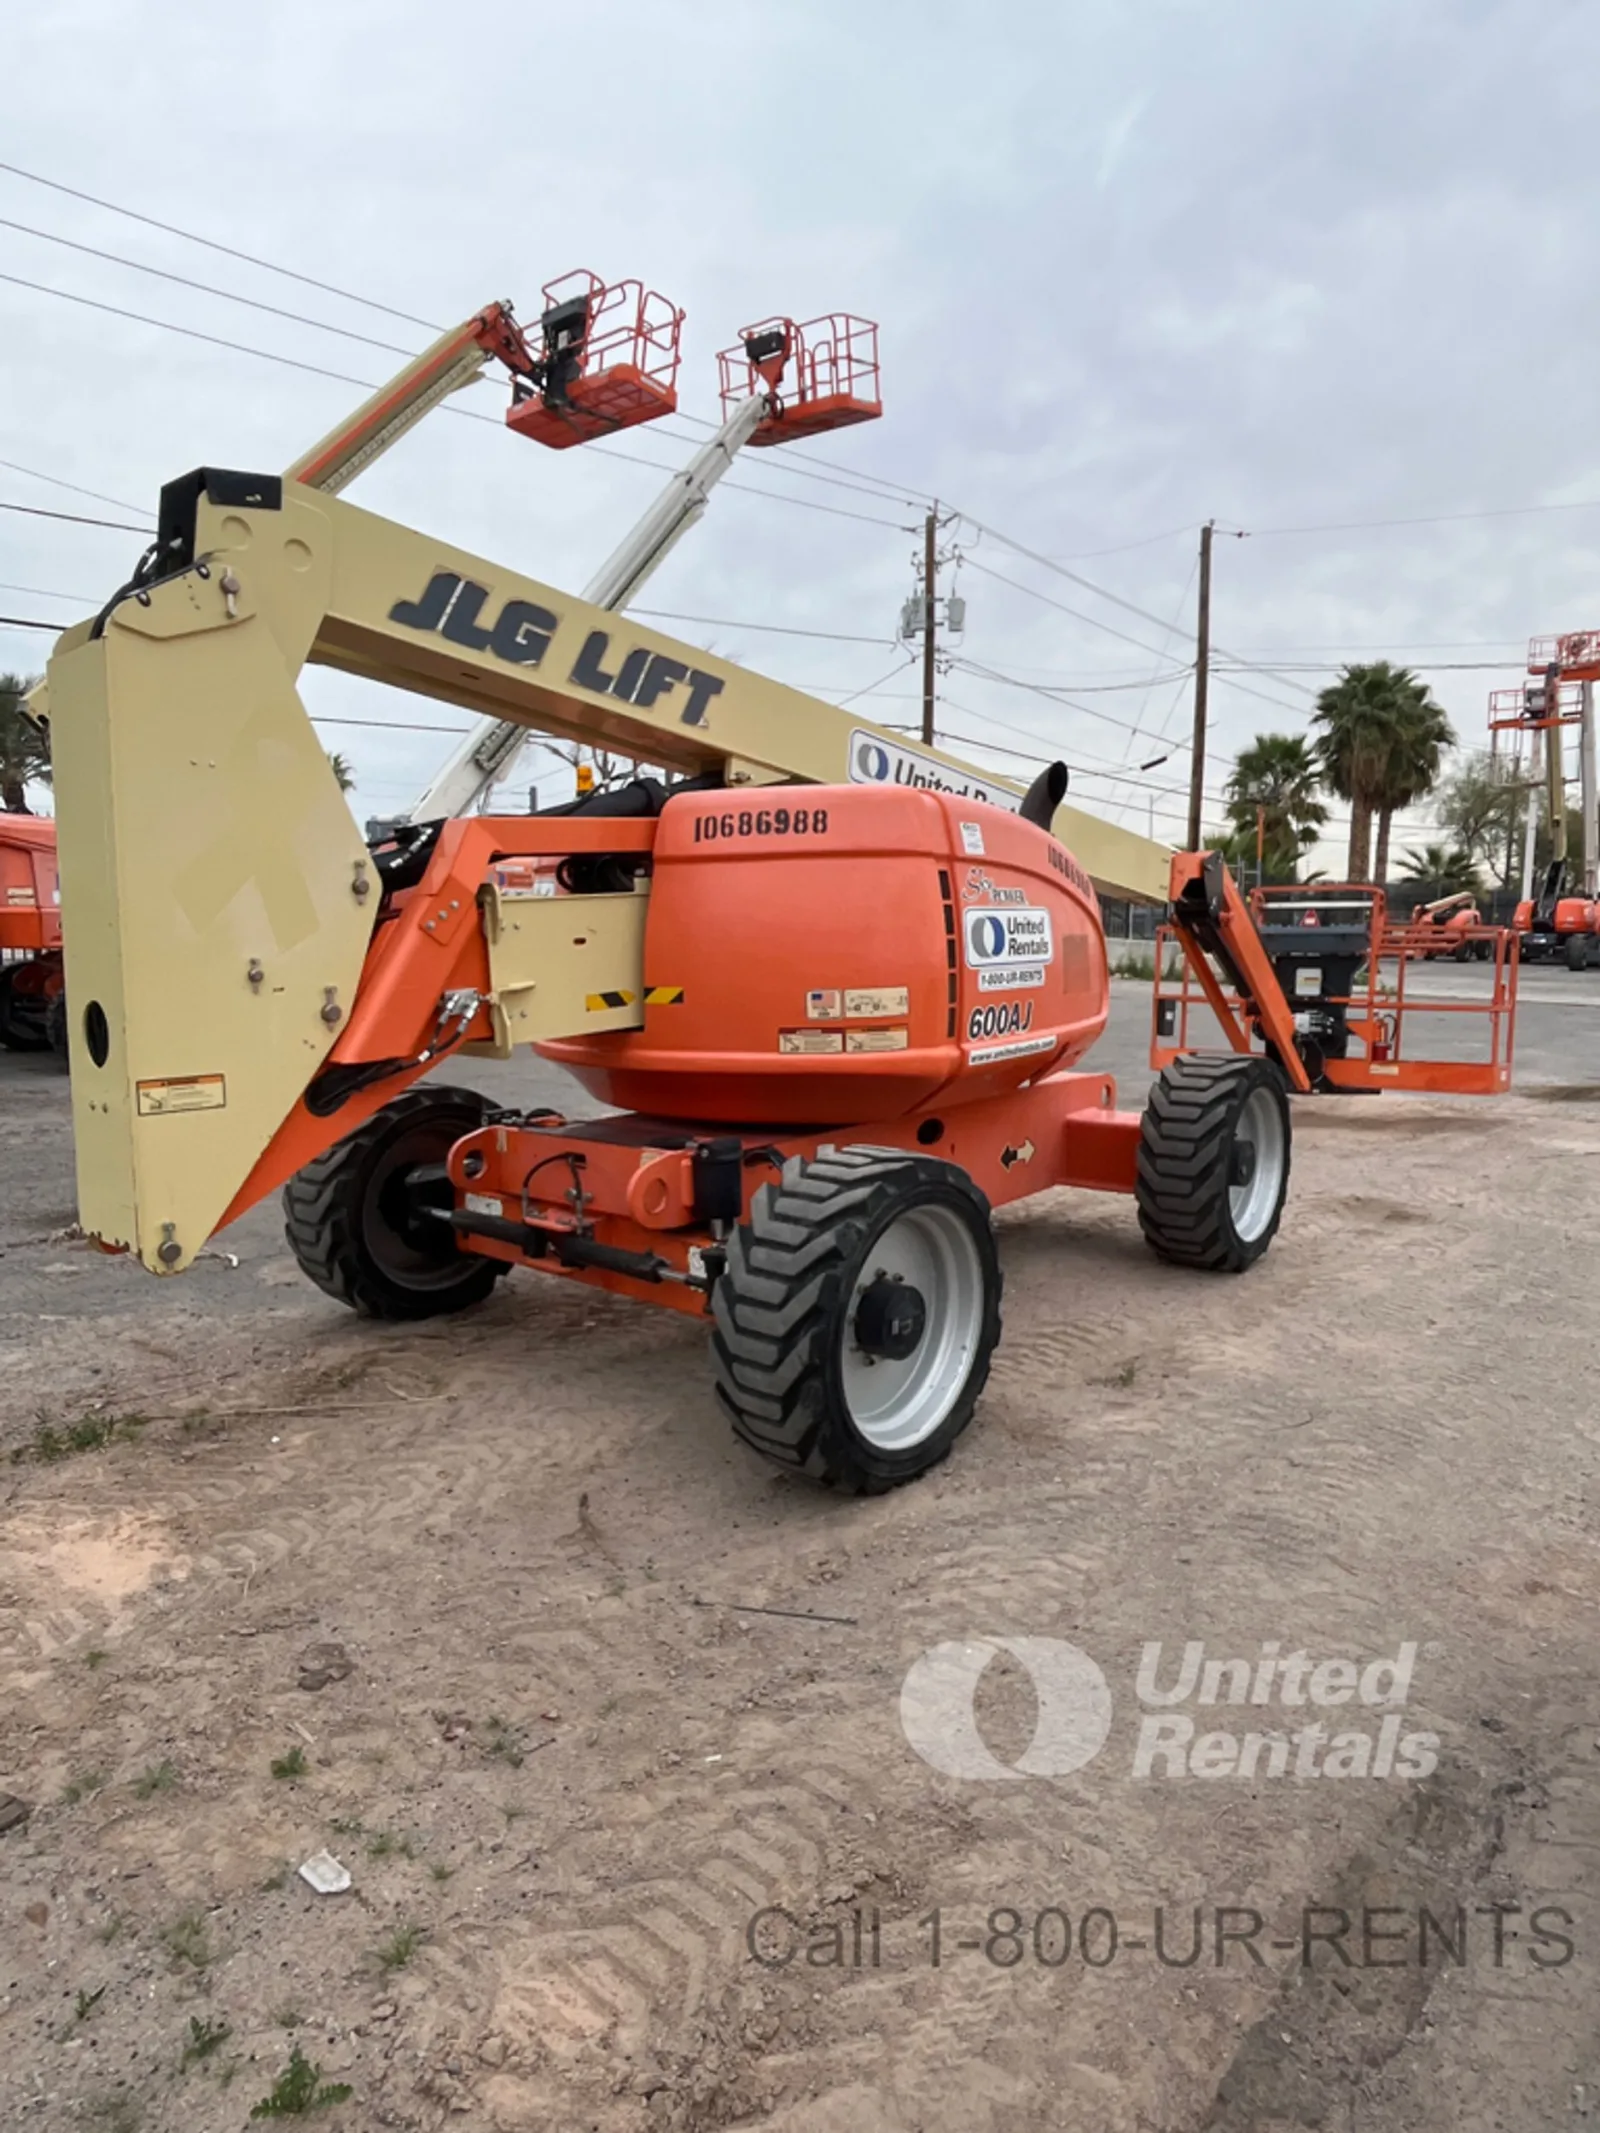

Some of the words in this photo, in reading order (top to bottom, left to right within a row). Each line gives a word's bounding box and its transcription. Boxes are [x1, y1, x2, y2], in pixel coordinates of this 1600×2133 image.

[388, 572, 558, 667] JLG
[568, 630, 725, 727] LIFT
[694, 808, 828, 842] 10686988
[1007, 916, 1044, 934] United
[1008, 937, 1049, 956] Rentals
[969, 1001, 1032, 1039] 600AJ
